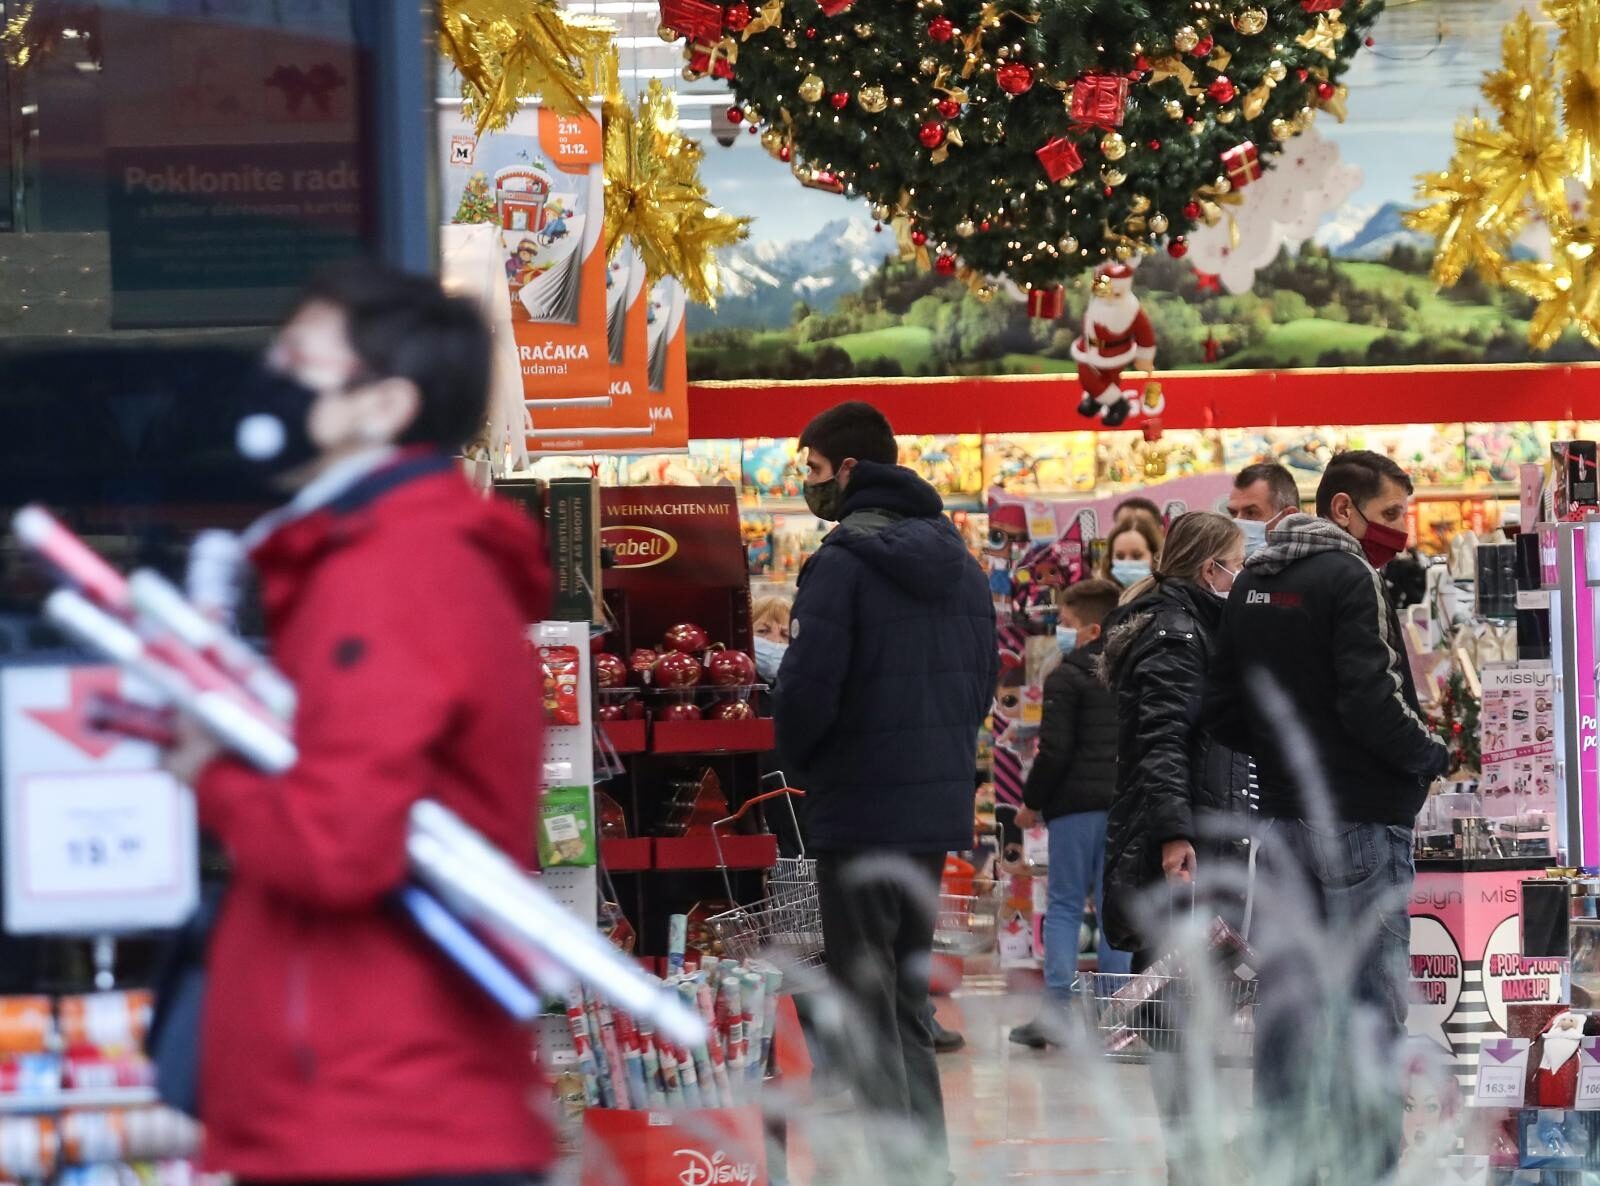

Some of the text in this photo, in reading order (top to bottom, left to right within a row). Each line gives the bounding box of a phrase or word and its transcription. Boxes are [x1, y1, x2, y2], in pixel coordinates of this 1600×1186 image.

[559, 144, 589, 155] 31.12.
[125, 166, 284, 193] Poklonite
[519, 341, 589, 360] RAČAKA
[522, 363, 568, 375] udama!
[607, 503, 731, 516] WEIHNACHTEN MIT
[574, 497, 583, 541] SMOOTH
[1481, 886, 1518, 903] Mis
[1502, 978, 1550, 1002] MAKEUP!
